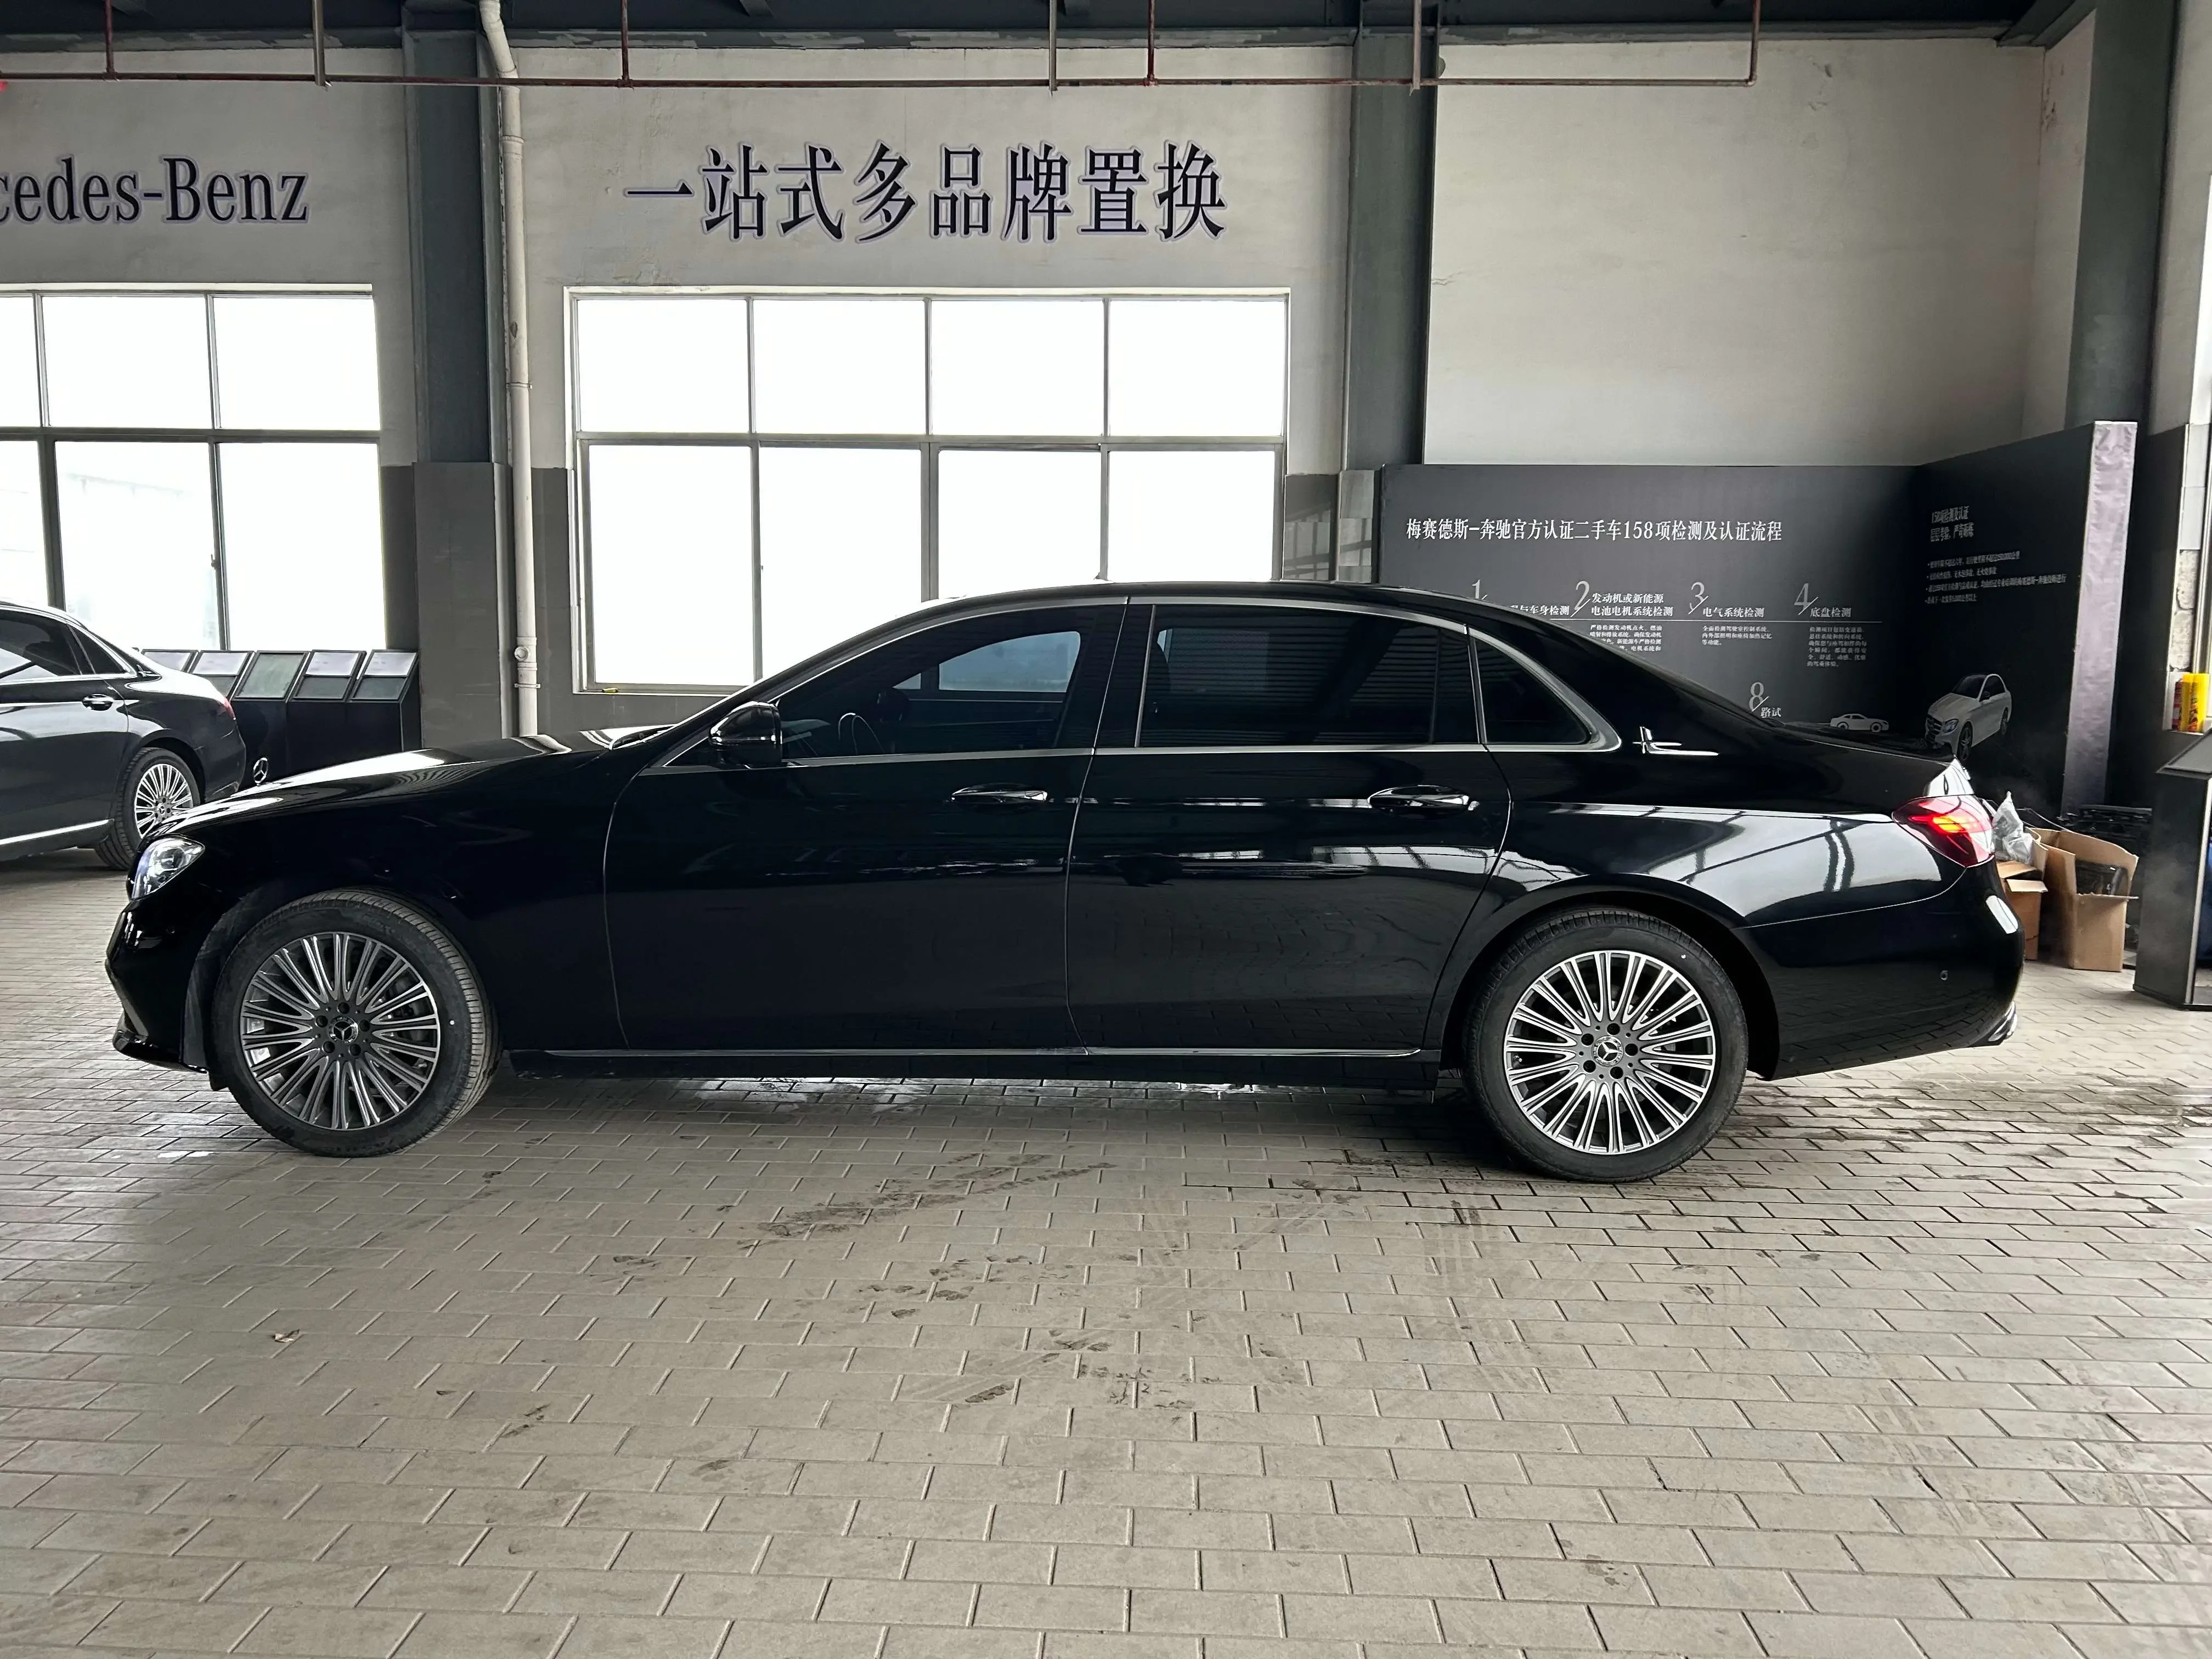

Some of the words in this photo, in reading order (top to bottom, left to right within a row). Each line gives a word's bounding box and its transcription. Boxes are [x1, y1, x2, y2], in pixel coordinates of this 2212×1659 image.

[624, 141, 1227, 243] 一站式多品牌置换
[1406, 518, 1782, 541] 梅赛德斯-奔驰官方认证二手车158项检测及认证流程
[1471, 579, 1481, 599] 1
[1575, 580, 1590, 611] 2
[1592, 593, 1664, 604] 发动机或新能源
[1690, 582, 1706, 611] 3
[1794, 582, 1812, 609] 4
[1510, 605, 1570, 616] 与车身检测
[1591, 606, 1673, 617] 电池电机系统检测
[1702, 607, 1765, 618] 电气系统检测
[1810, 607, 1852, 618] 底盘检测
[1749, 682, 1764, 712] 8
[1760, 707, 1782, 718] 路试
